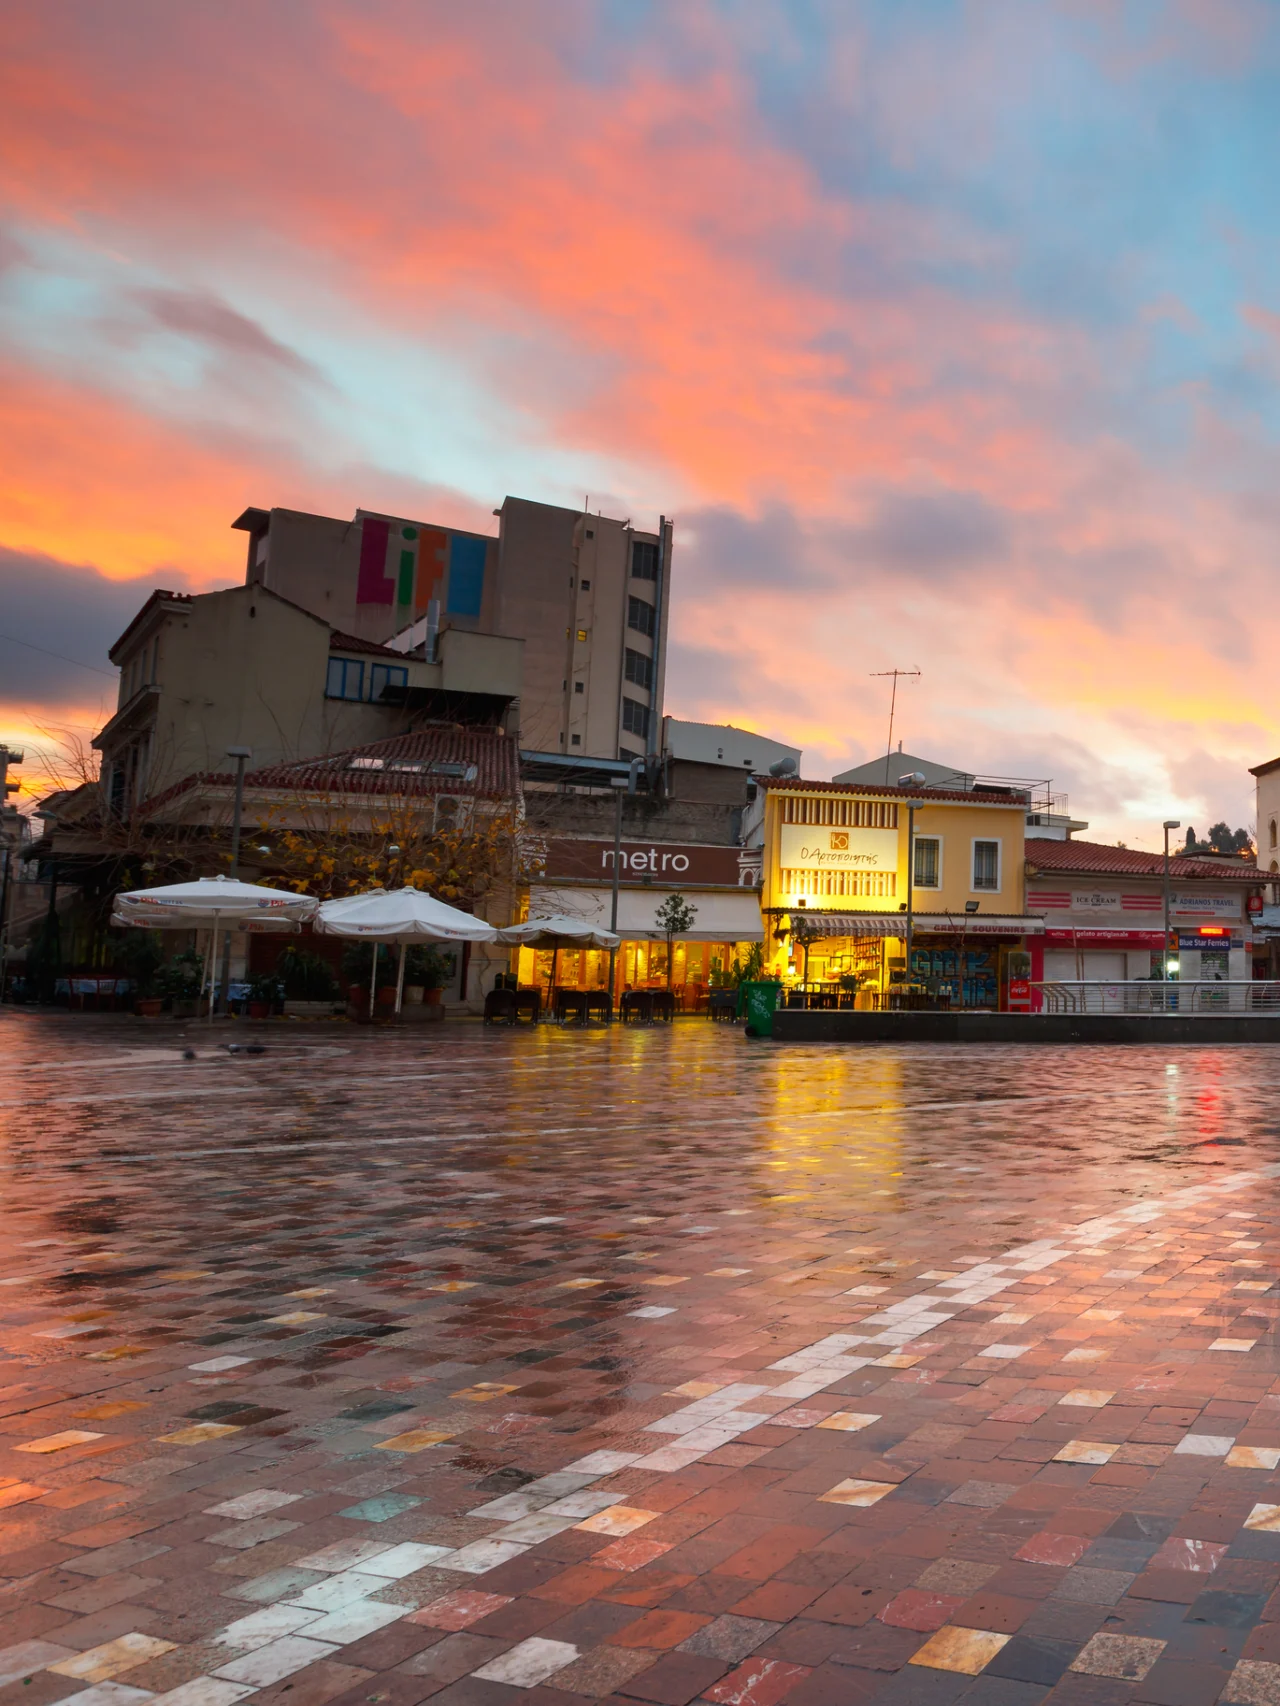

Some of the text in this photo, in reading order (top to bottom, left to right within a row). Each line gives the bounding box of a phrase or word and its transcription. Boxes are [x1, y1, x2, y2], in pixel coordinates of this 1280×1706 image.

[602, 848, 690, 872] metro
[1179, 898, 1211, 906] ADRIANOS
[933, 924, 966, 933] GREEK
[972, 925, 1026, 934] SOUVENIRS
[1076, 930, 1096, 938] gelato
[1194, 939, 1207, 947] Star
[1207, 939, 1229, 947] Ferries
